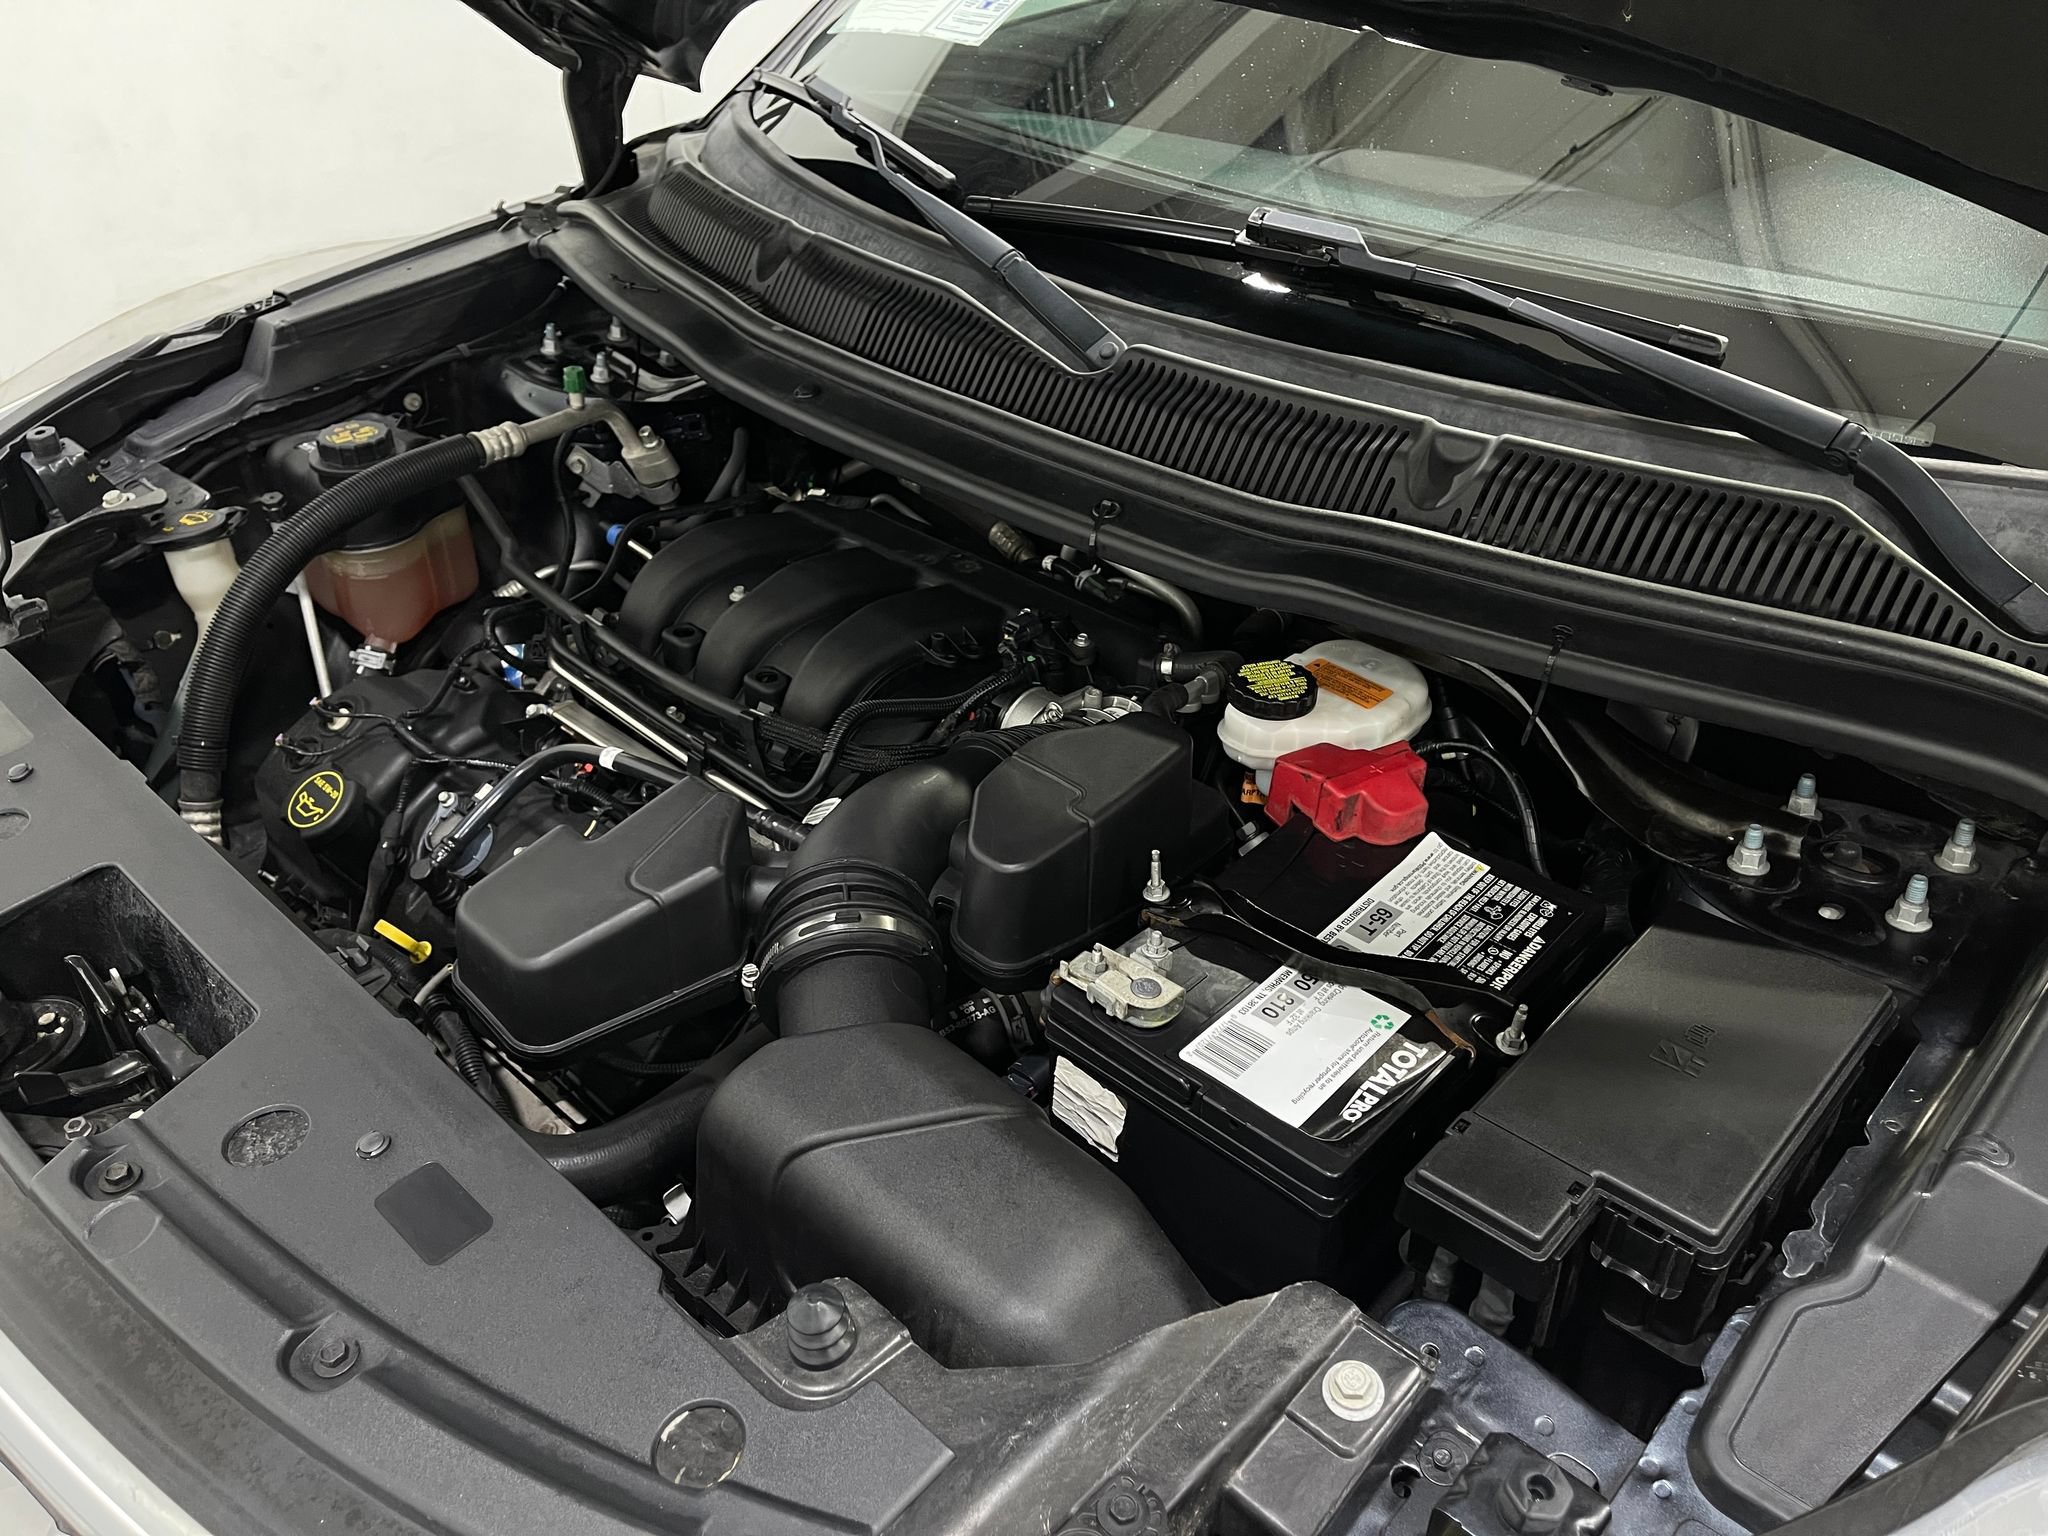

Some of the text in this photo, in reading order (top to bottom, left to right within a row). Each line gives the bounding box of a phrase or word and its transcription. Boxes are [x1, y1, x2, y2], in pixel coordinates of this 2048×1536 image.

[1340, 897, 1374, 926] DISTRIBUTED
[1333, 924, 1344, 932] BY
[1356, 906, 1394, 936] 65-T
[1254, 991, 1266, 1000] TN
[1259, 991, 1296, 1020] 810
[1362, 1031, 1381, 1047] Return
[1350, 1046, 1365, 1058] used
[1329, 1059, 1339, 1068] for
[1329, 1057, 1353, 1078] batteries
[1312, 1066, 1332, 1083] proper
[1290, 1082, 1316, 1104] recycling
